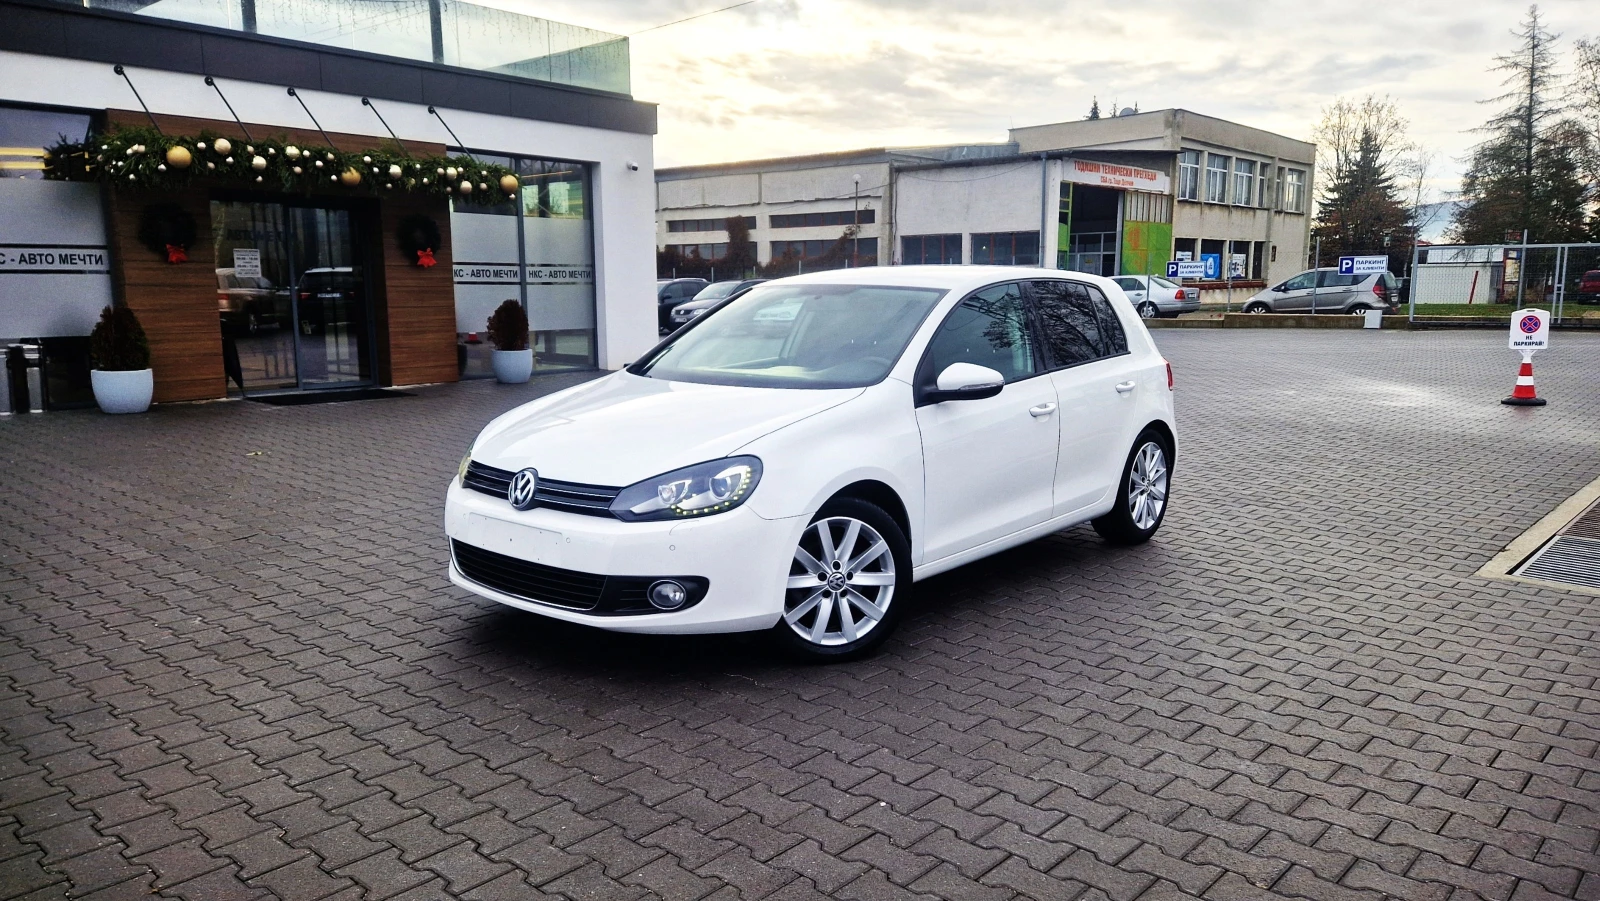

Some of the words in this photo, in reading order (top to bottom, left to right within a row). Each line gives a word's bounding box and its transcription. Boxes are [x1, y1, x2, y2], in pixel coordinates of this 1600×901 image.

[18, 253, 55, 265] АВТО
[58, 253, 104, 266] МЕЧТИ
[1168, 264, 1177, 275] P
[1342, 259, 1353, 272] P
[470, 269, 491, 278] АВТО
[493, 269, 518, 279] МЕЧТИ
[528, 270, 543, 279] НКС
[549, 270, 566, 279] АВТО
[568, 270, 591, 279] МЕЧТИ
